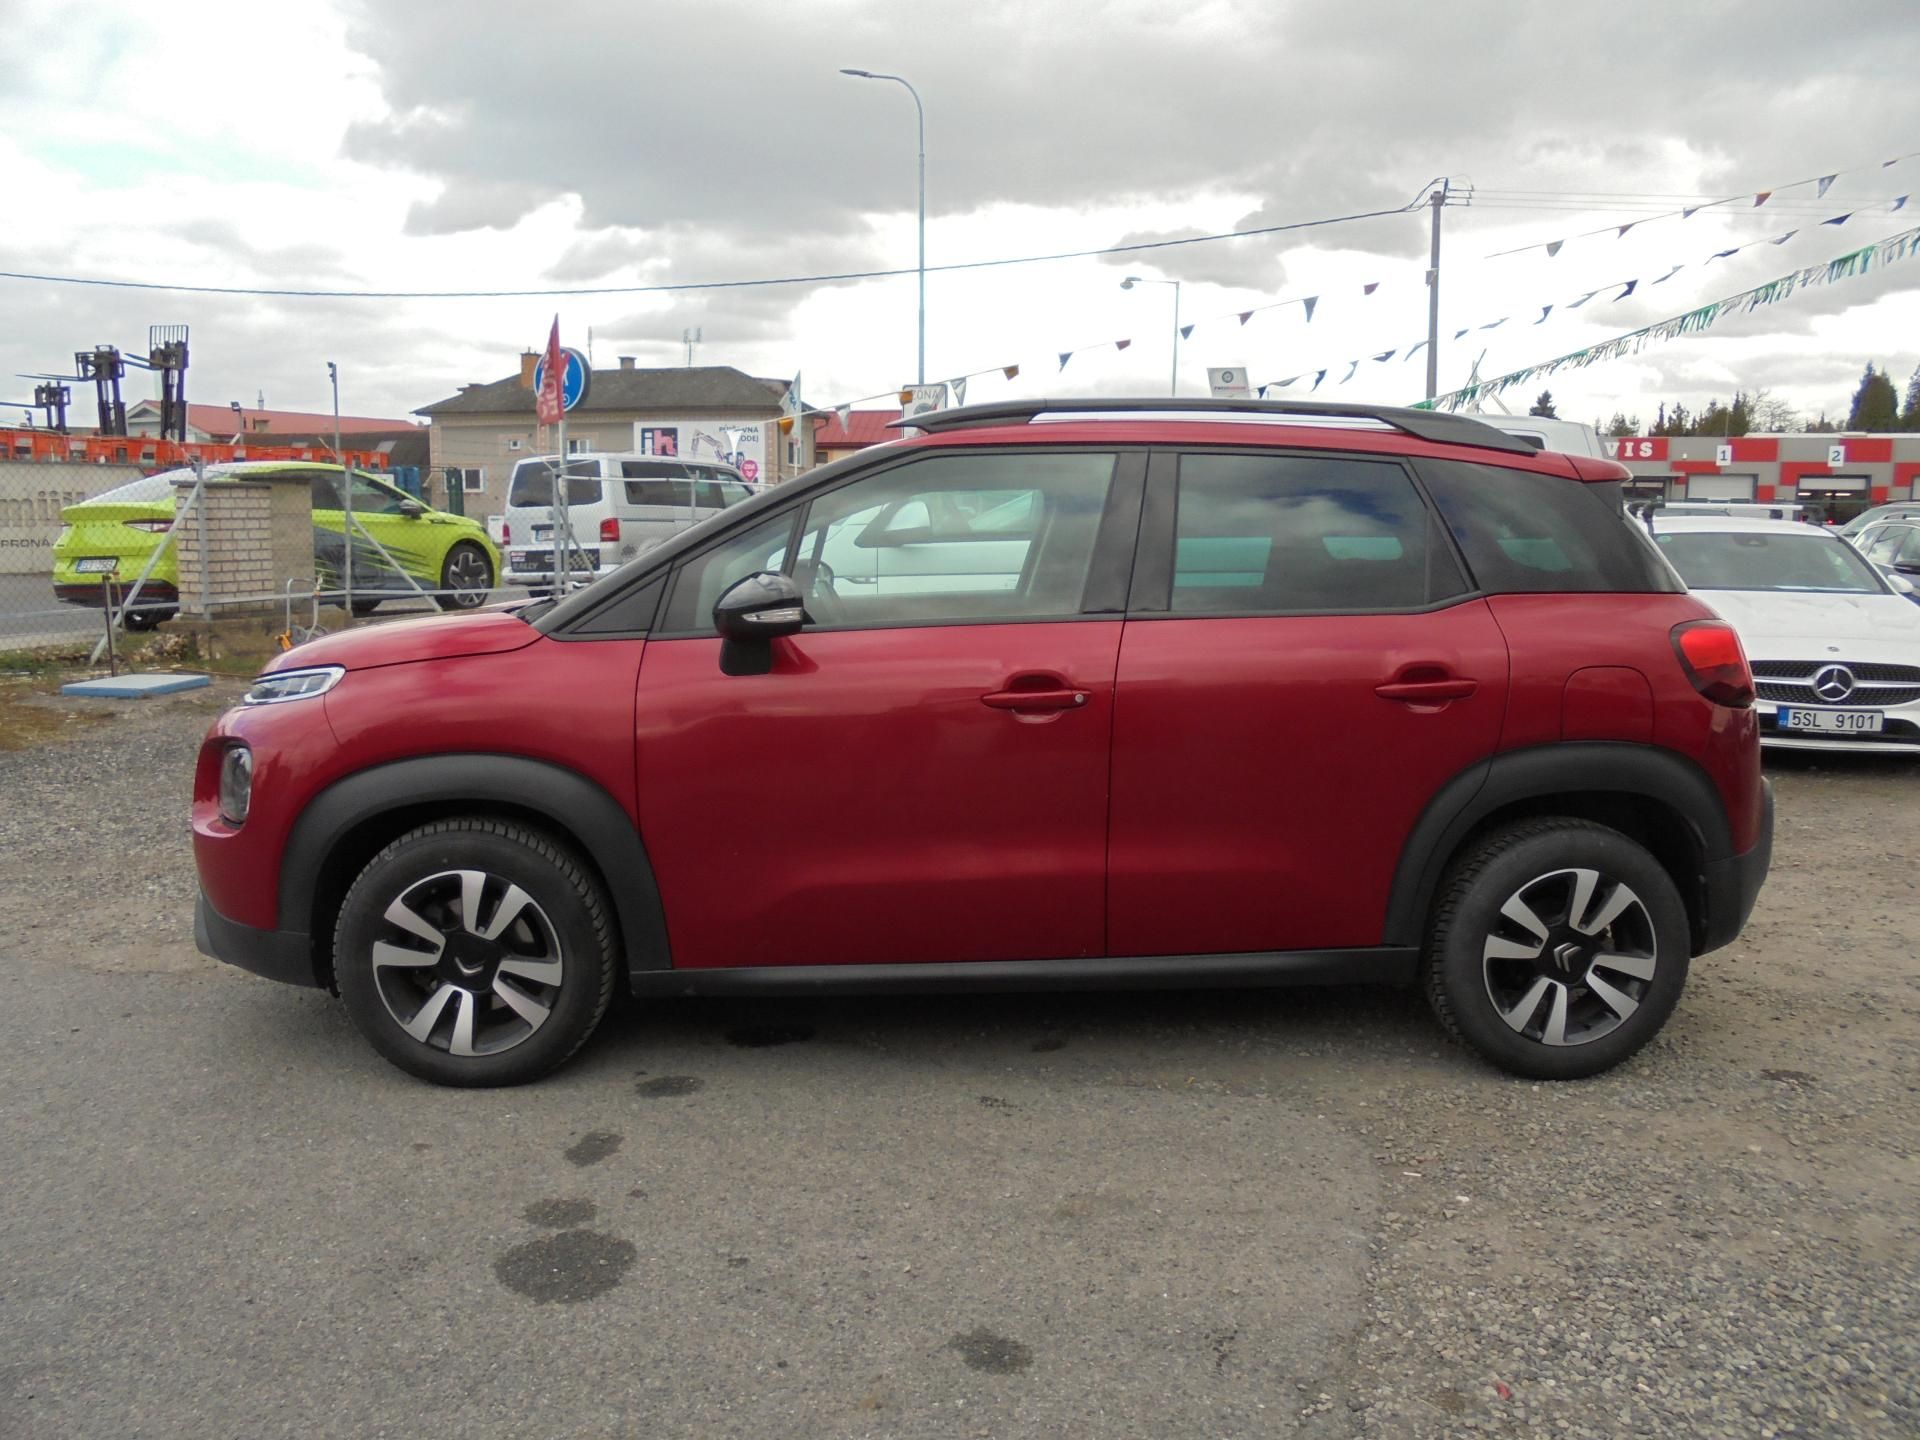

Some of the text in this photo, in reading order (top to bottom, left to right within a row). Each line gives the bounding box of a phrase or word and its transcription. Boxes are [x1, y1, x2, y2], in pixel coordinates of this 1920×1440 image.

[1719, 449, 1728, 461] 1
[1831, 450, 1841, 462] 2
[1792, 711, 1875, 729] 5SL 9101
